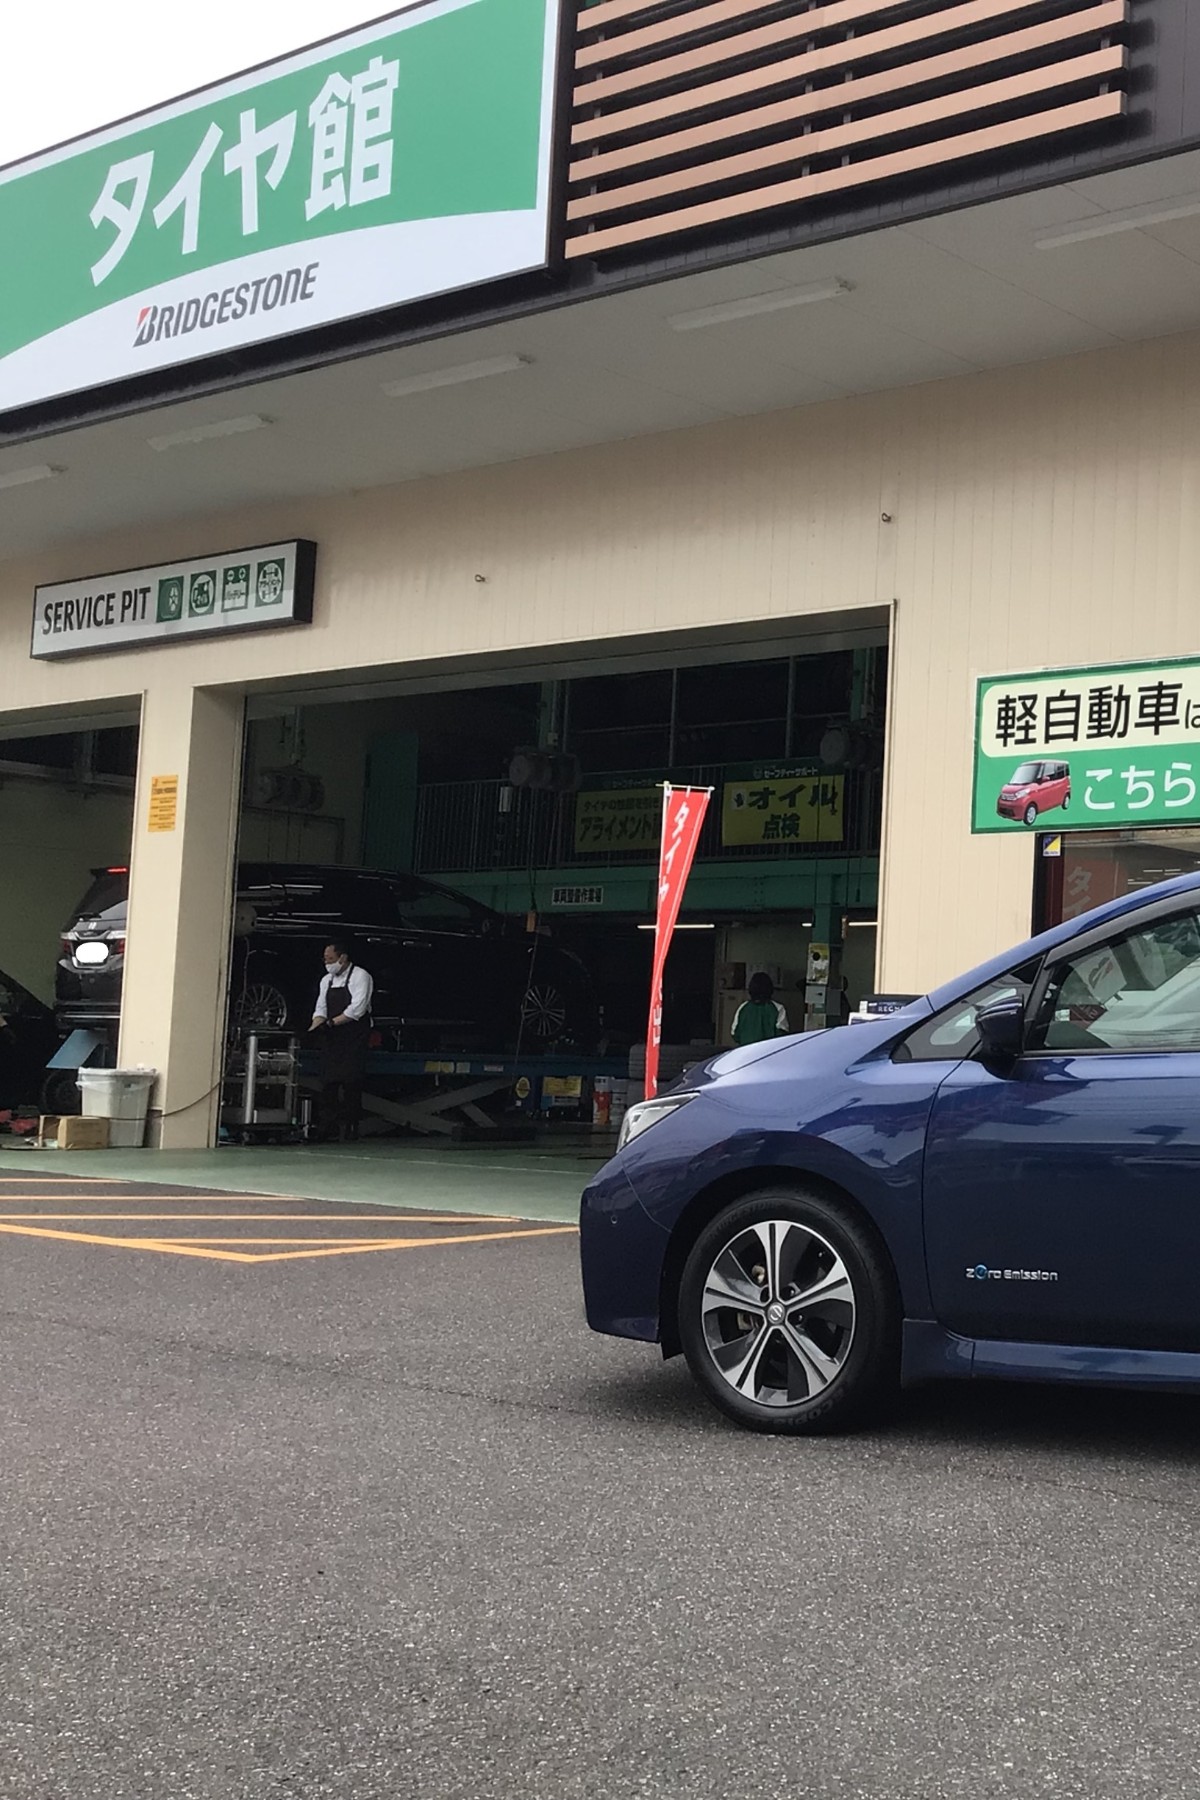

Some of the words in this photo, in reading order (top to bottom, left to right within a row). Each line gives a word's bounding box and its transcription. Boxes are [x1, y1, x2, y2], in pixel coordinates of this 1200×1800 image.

[89, 56, 400, 287] タイヤ館
[133, 262, 319, 347] BRIDGESTONE
[42, 592, 116, 635] SERVICE
[120, 587, 151, 623] PIT
[748, 784, 839, 810] オイル
[1083, 762, 1196, 809] こちら
[762, 813, 800, 839] 点検
[1004, 1269, 1058, 1281] Emission
